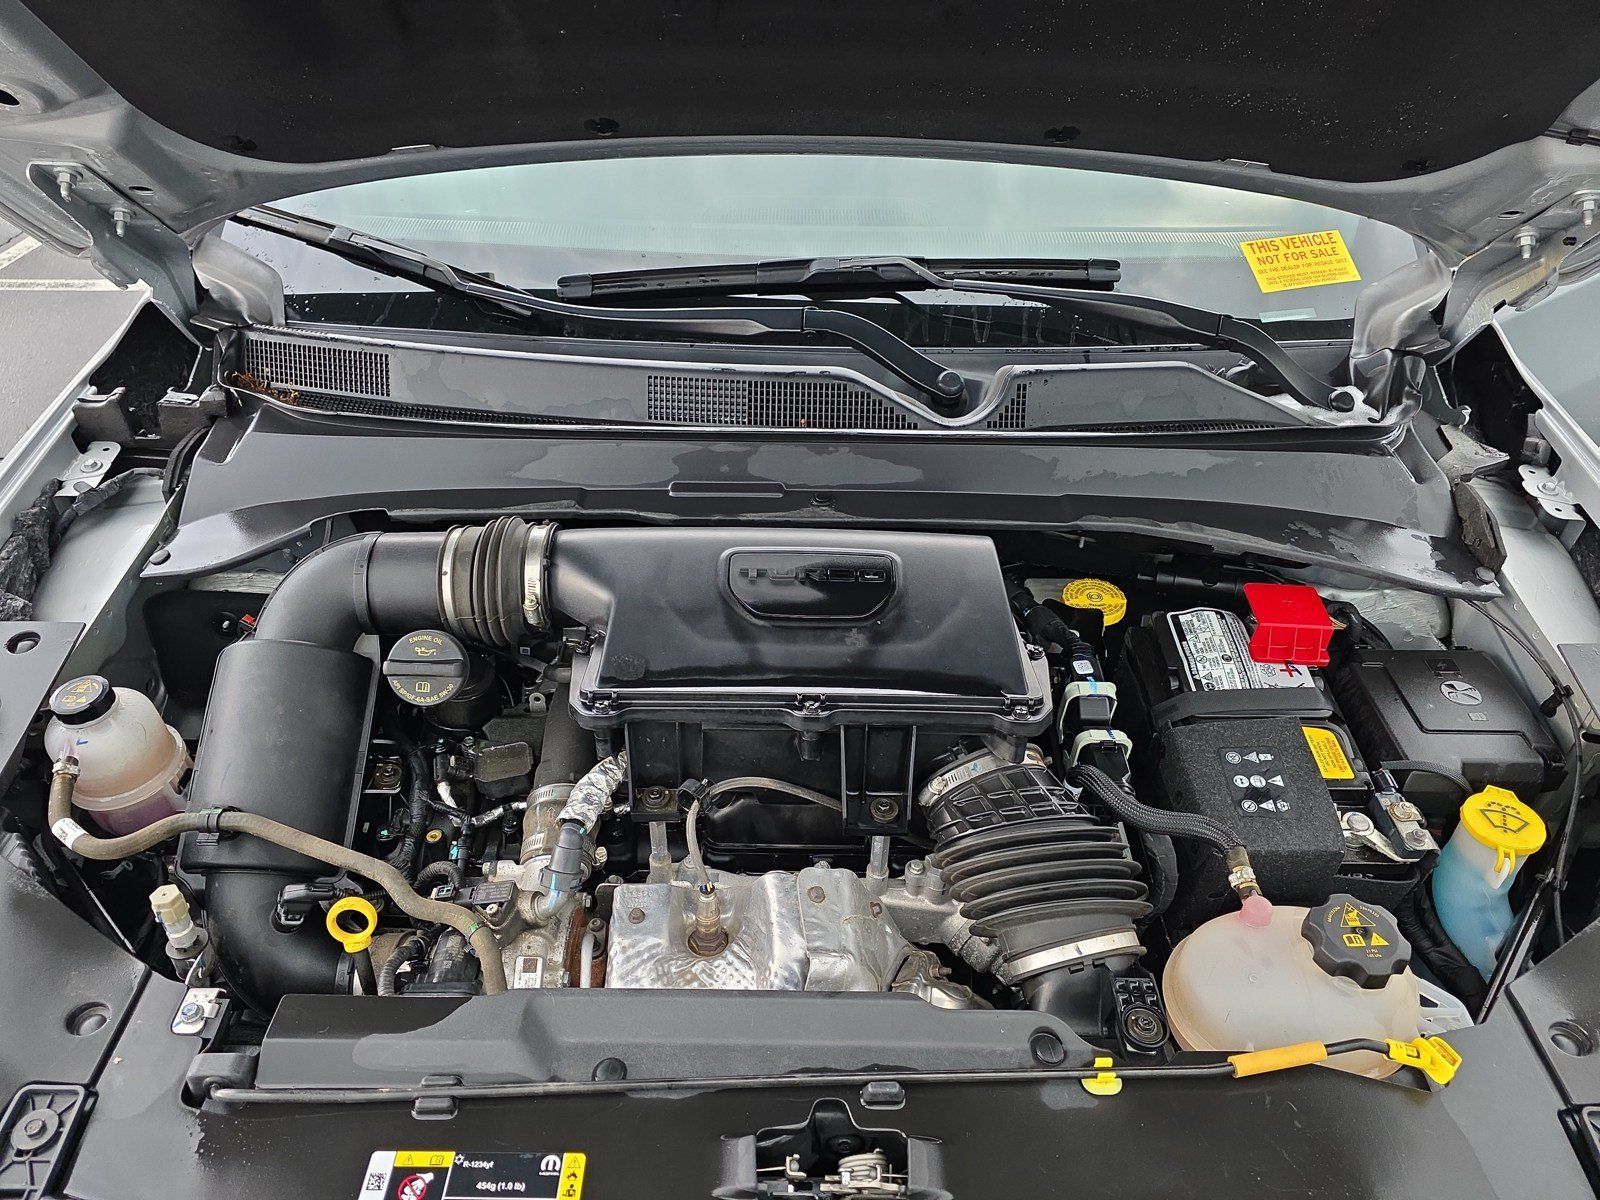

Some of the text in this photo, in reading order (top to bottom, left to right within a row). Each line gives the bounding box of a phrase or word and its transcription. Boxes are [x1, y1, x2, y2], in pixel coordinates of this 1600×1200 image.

[1247, 233, 1337, 254] THIS VEHICLE
[1256, 247, 1340, 265] NOT FOR SALE
[739, 568, 886, 582] TURBO
[409, 635, 443, 646] ENGINE OIL
[392, 679, 402, 690] API
[463, 1161, 494, 1169] R-1234yf
[476, 1182, 526, 1192] 454g (1.0 lb)
